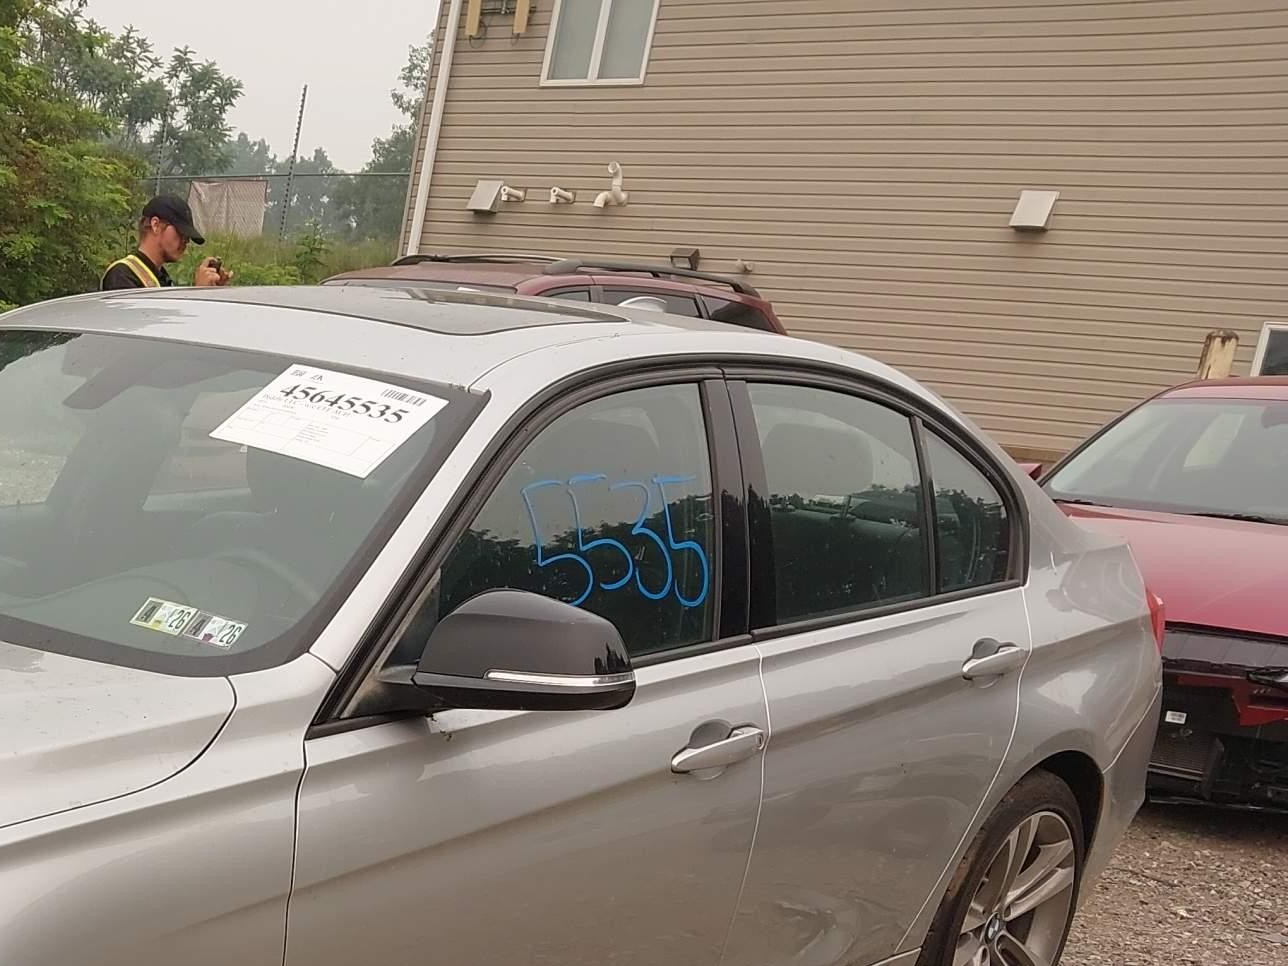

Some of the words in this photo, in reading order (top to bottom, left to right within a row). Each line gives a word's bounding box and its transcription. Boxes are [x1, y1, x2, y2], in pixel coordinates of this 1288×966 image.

[279, 384, 410, 424] 45645535
[520, 474, 709, 608] 5535
[168, 609, 191, 629] 26
[219, 624, 242, 645] 26
